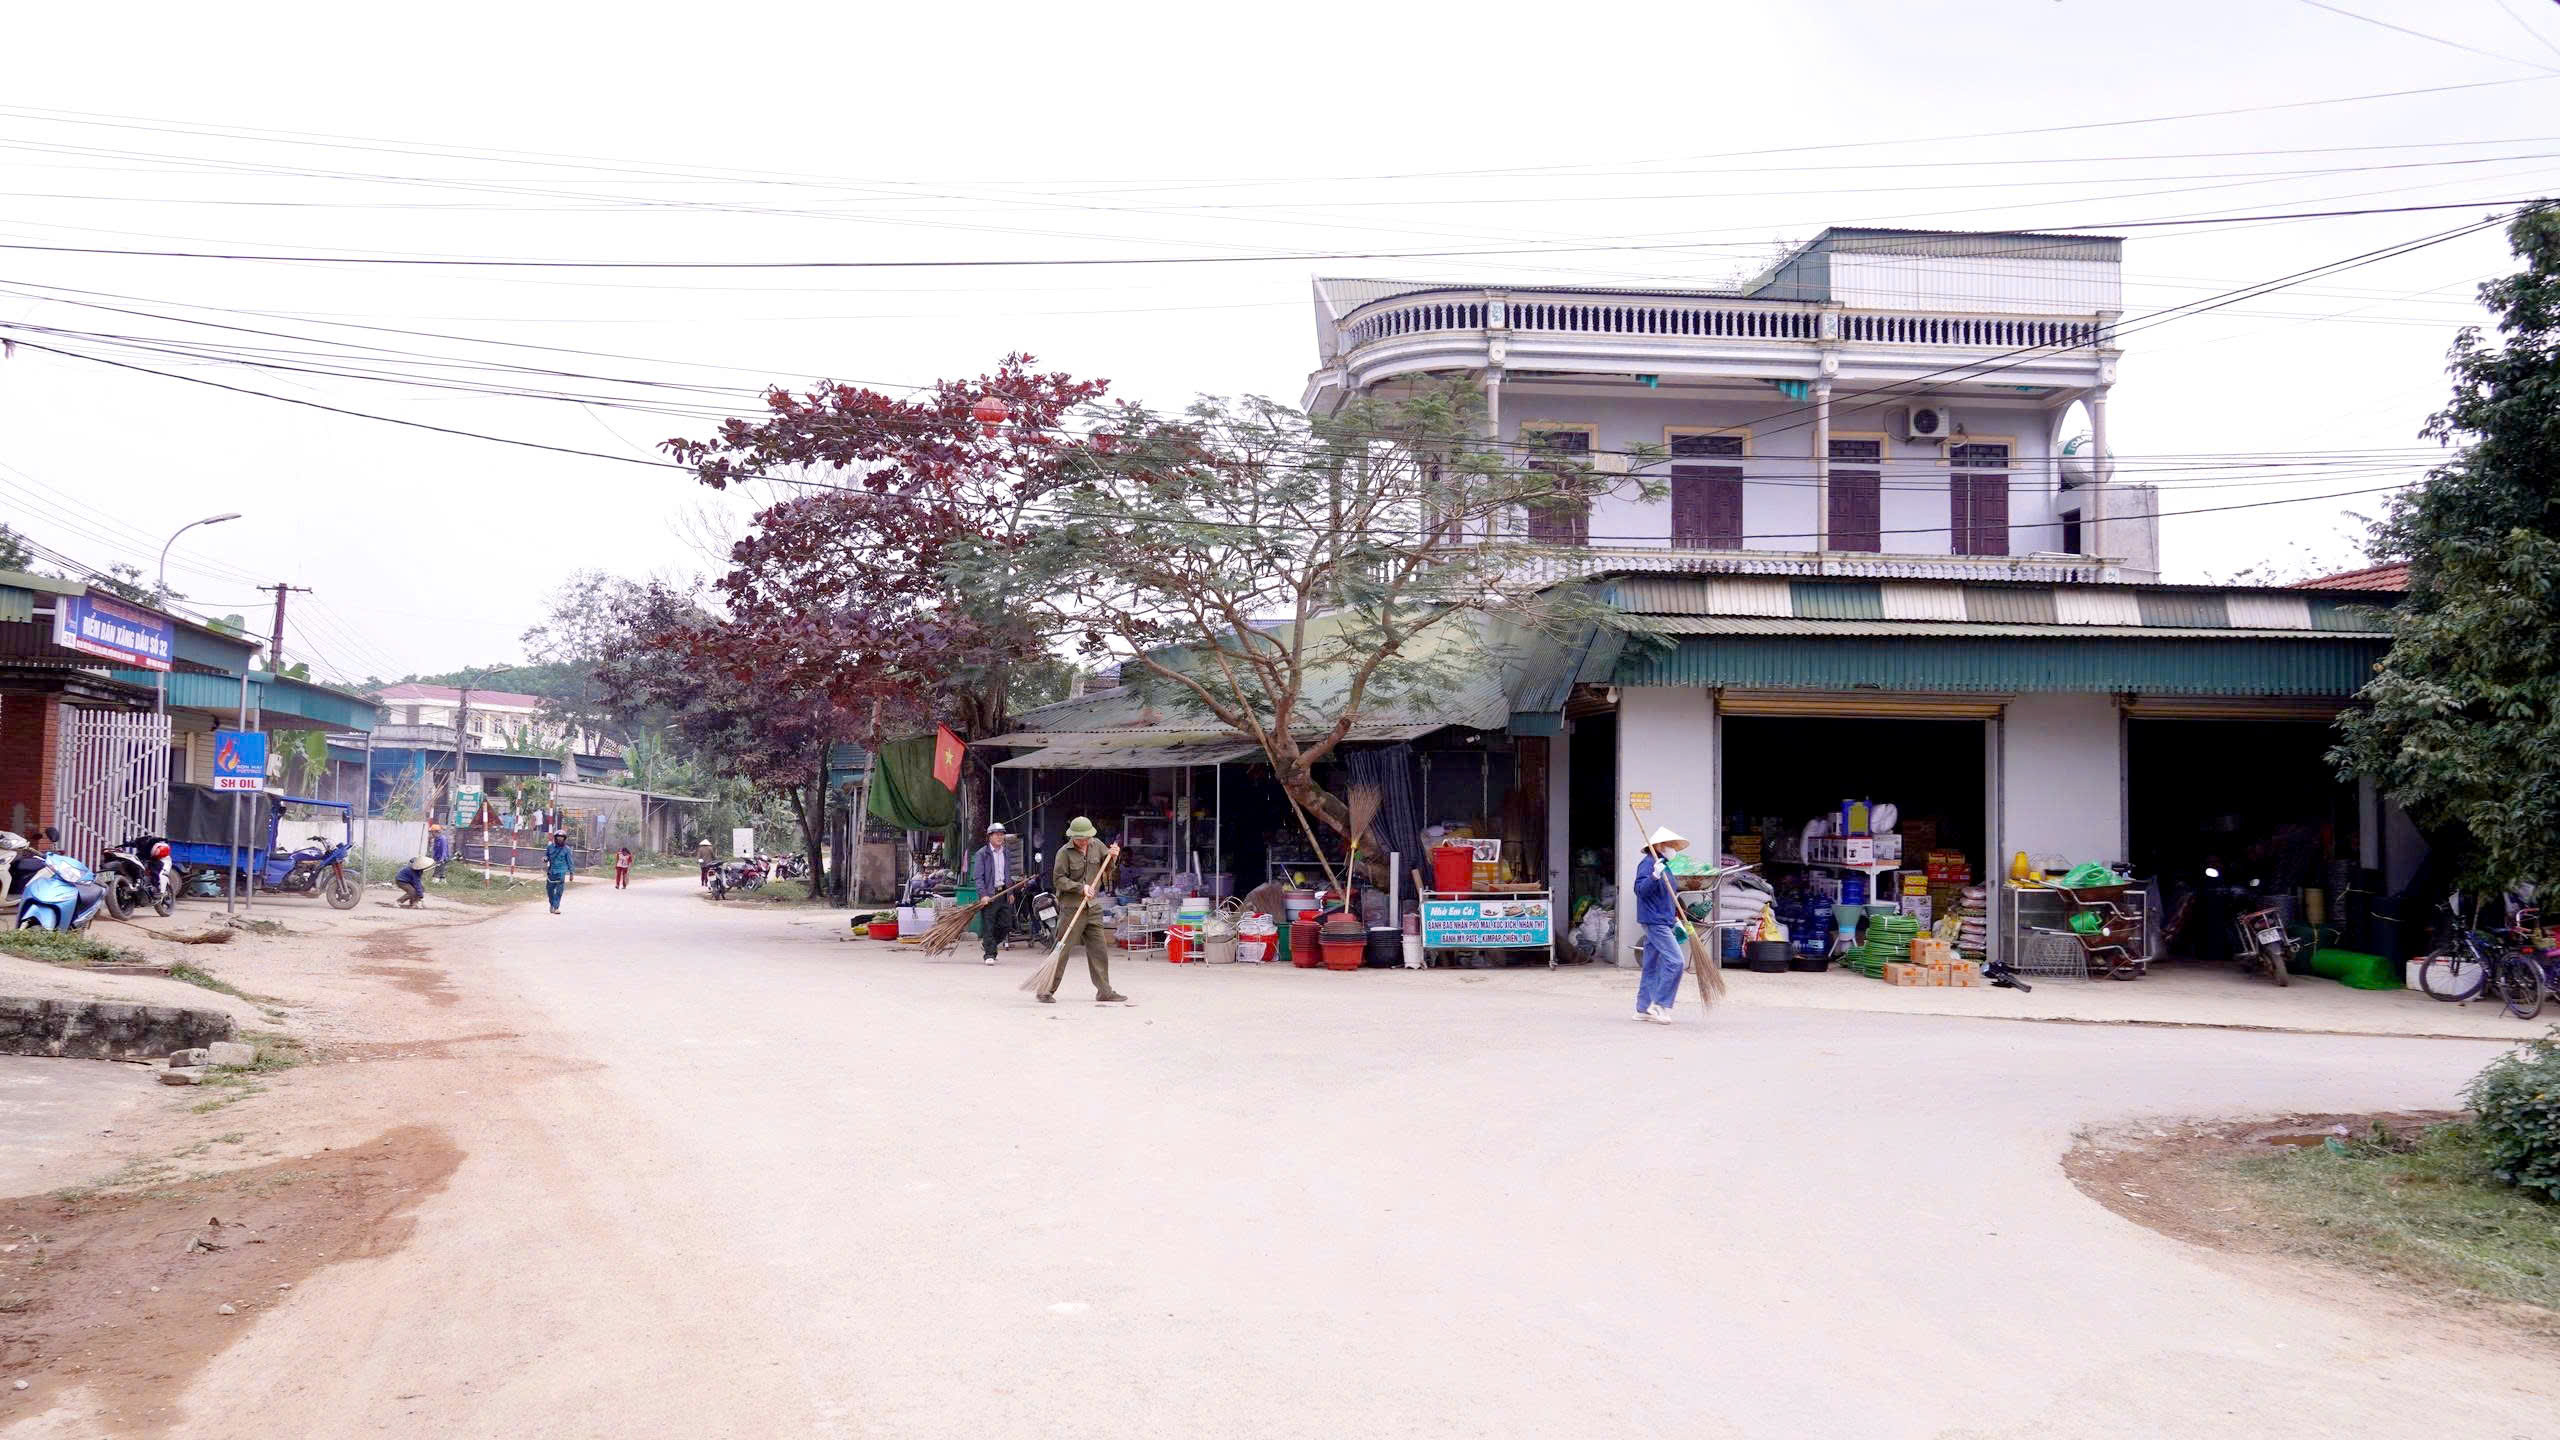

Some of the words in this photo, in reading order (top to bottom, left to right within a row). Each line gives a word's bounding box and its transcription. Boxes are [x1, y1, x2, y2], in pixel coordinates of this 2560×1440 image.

[101, 620, 116, 643] BÁN
[149, 633, 160, 654] SỐ
[159, 640, 168, 657] 32
[221, 779, 236, 788] SH
[239, 779, 257, 788] OIL
[1442, 921, 1454, 930] BAO
